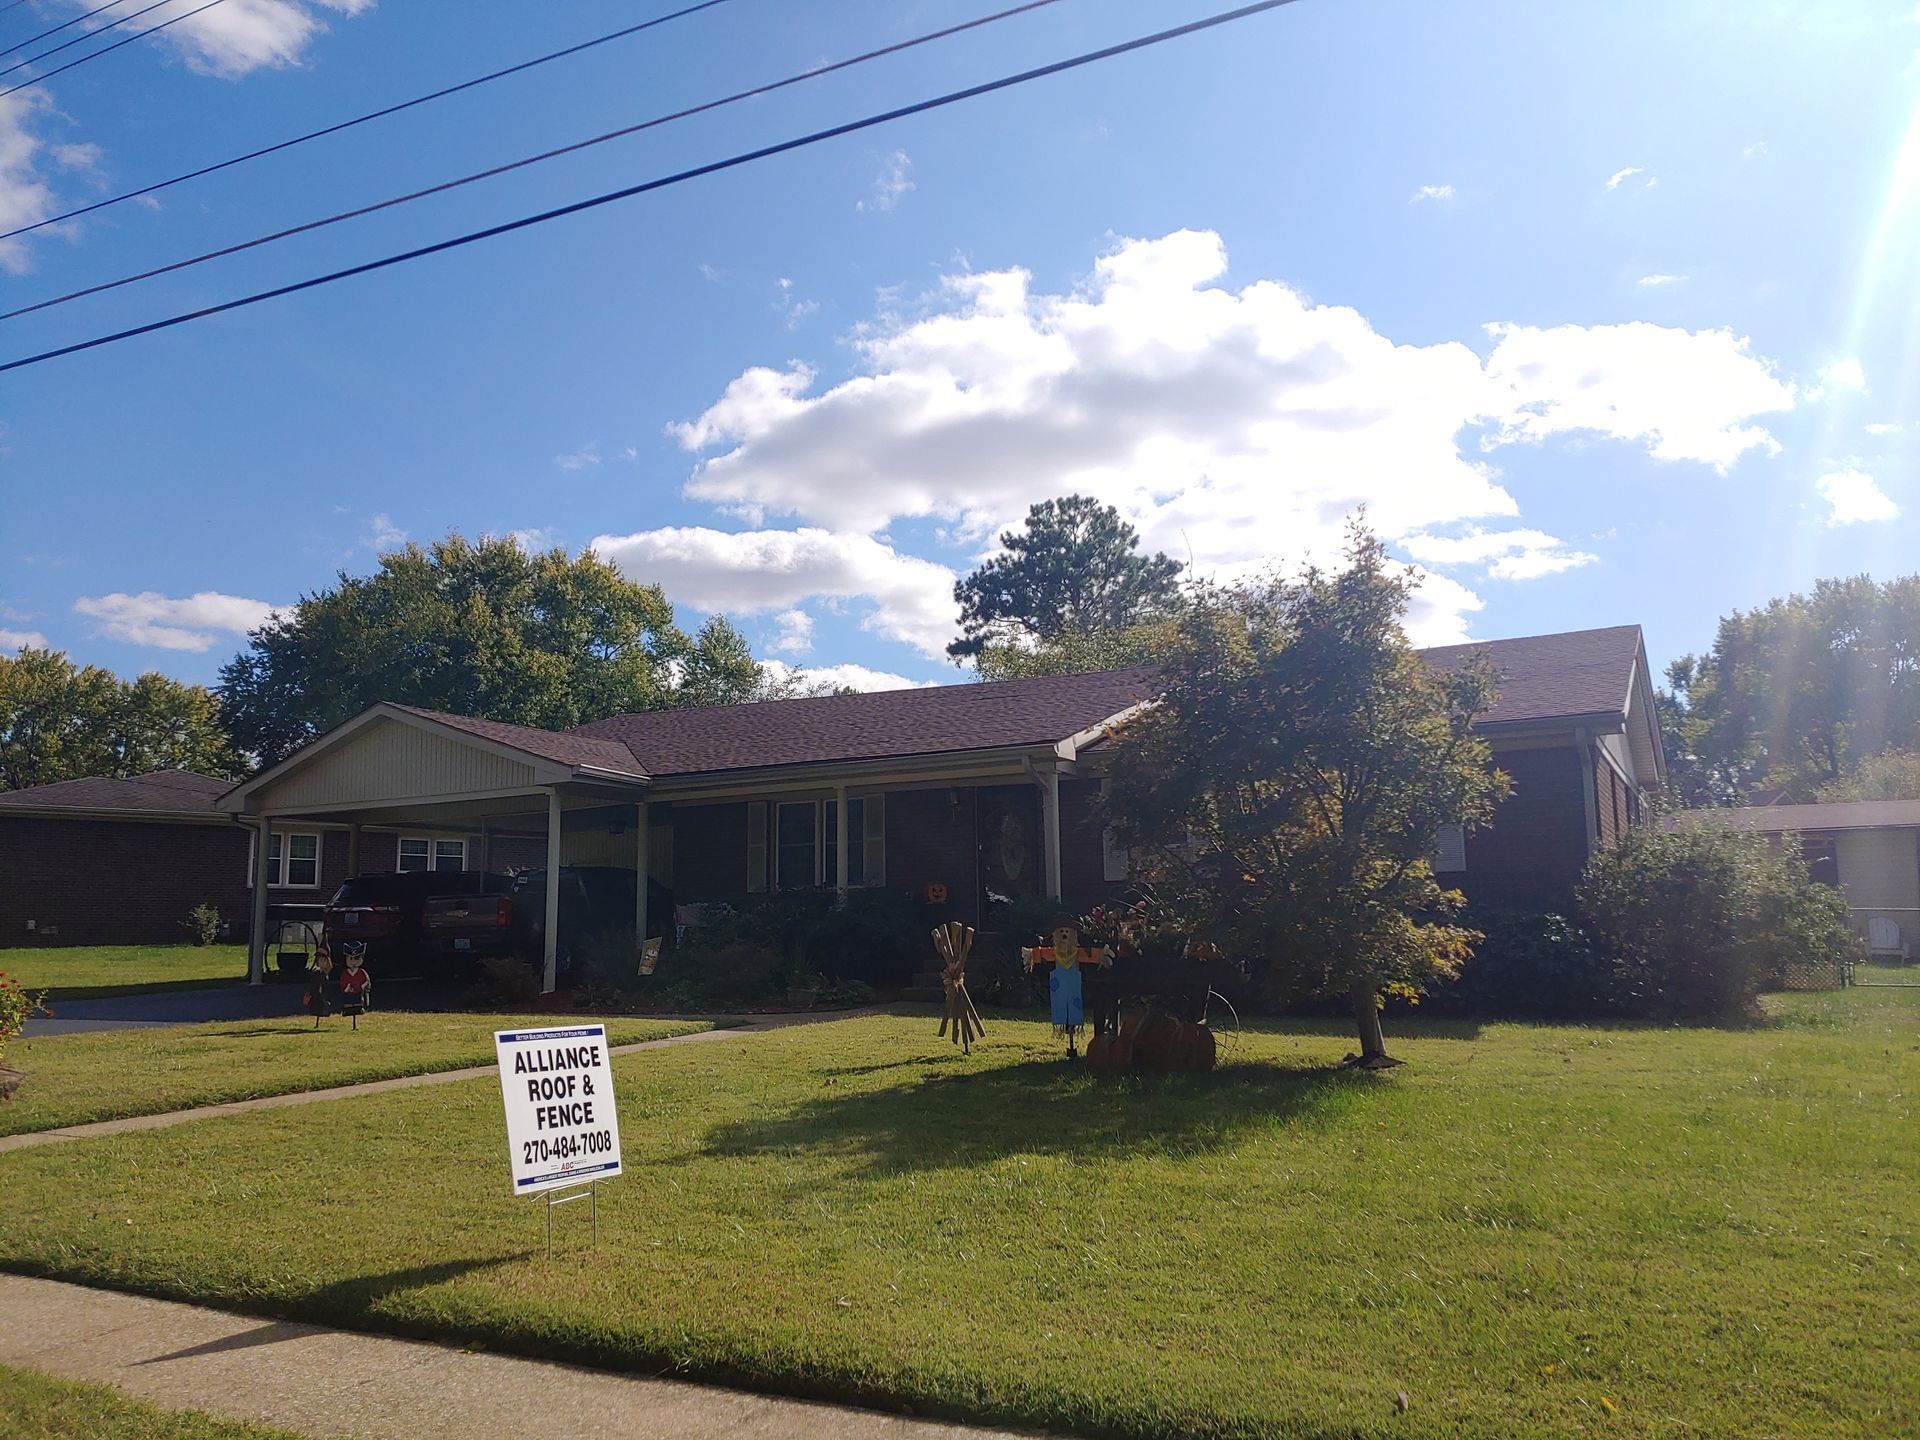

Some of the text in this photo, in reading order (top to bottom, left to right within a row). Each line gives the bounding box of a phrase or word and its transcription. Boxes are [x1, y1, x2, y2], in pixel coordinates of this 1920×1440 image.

[514, 1046, 601, 1074] ALLIANCE
[528, 1074, 595, 1102] ROOF &
[536, 1102, 594, 1130] FENCE
[523, 1130, 612, 1164] 270-484-7008
